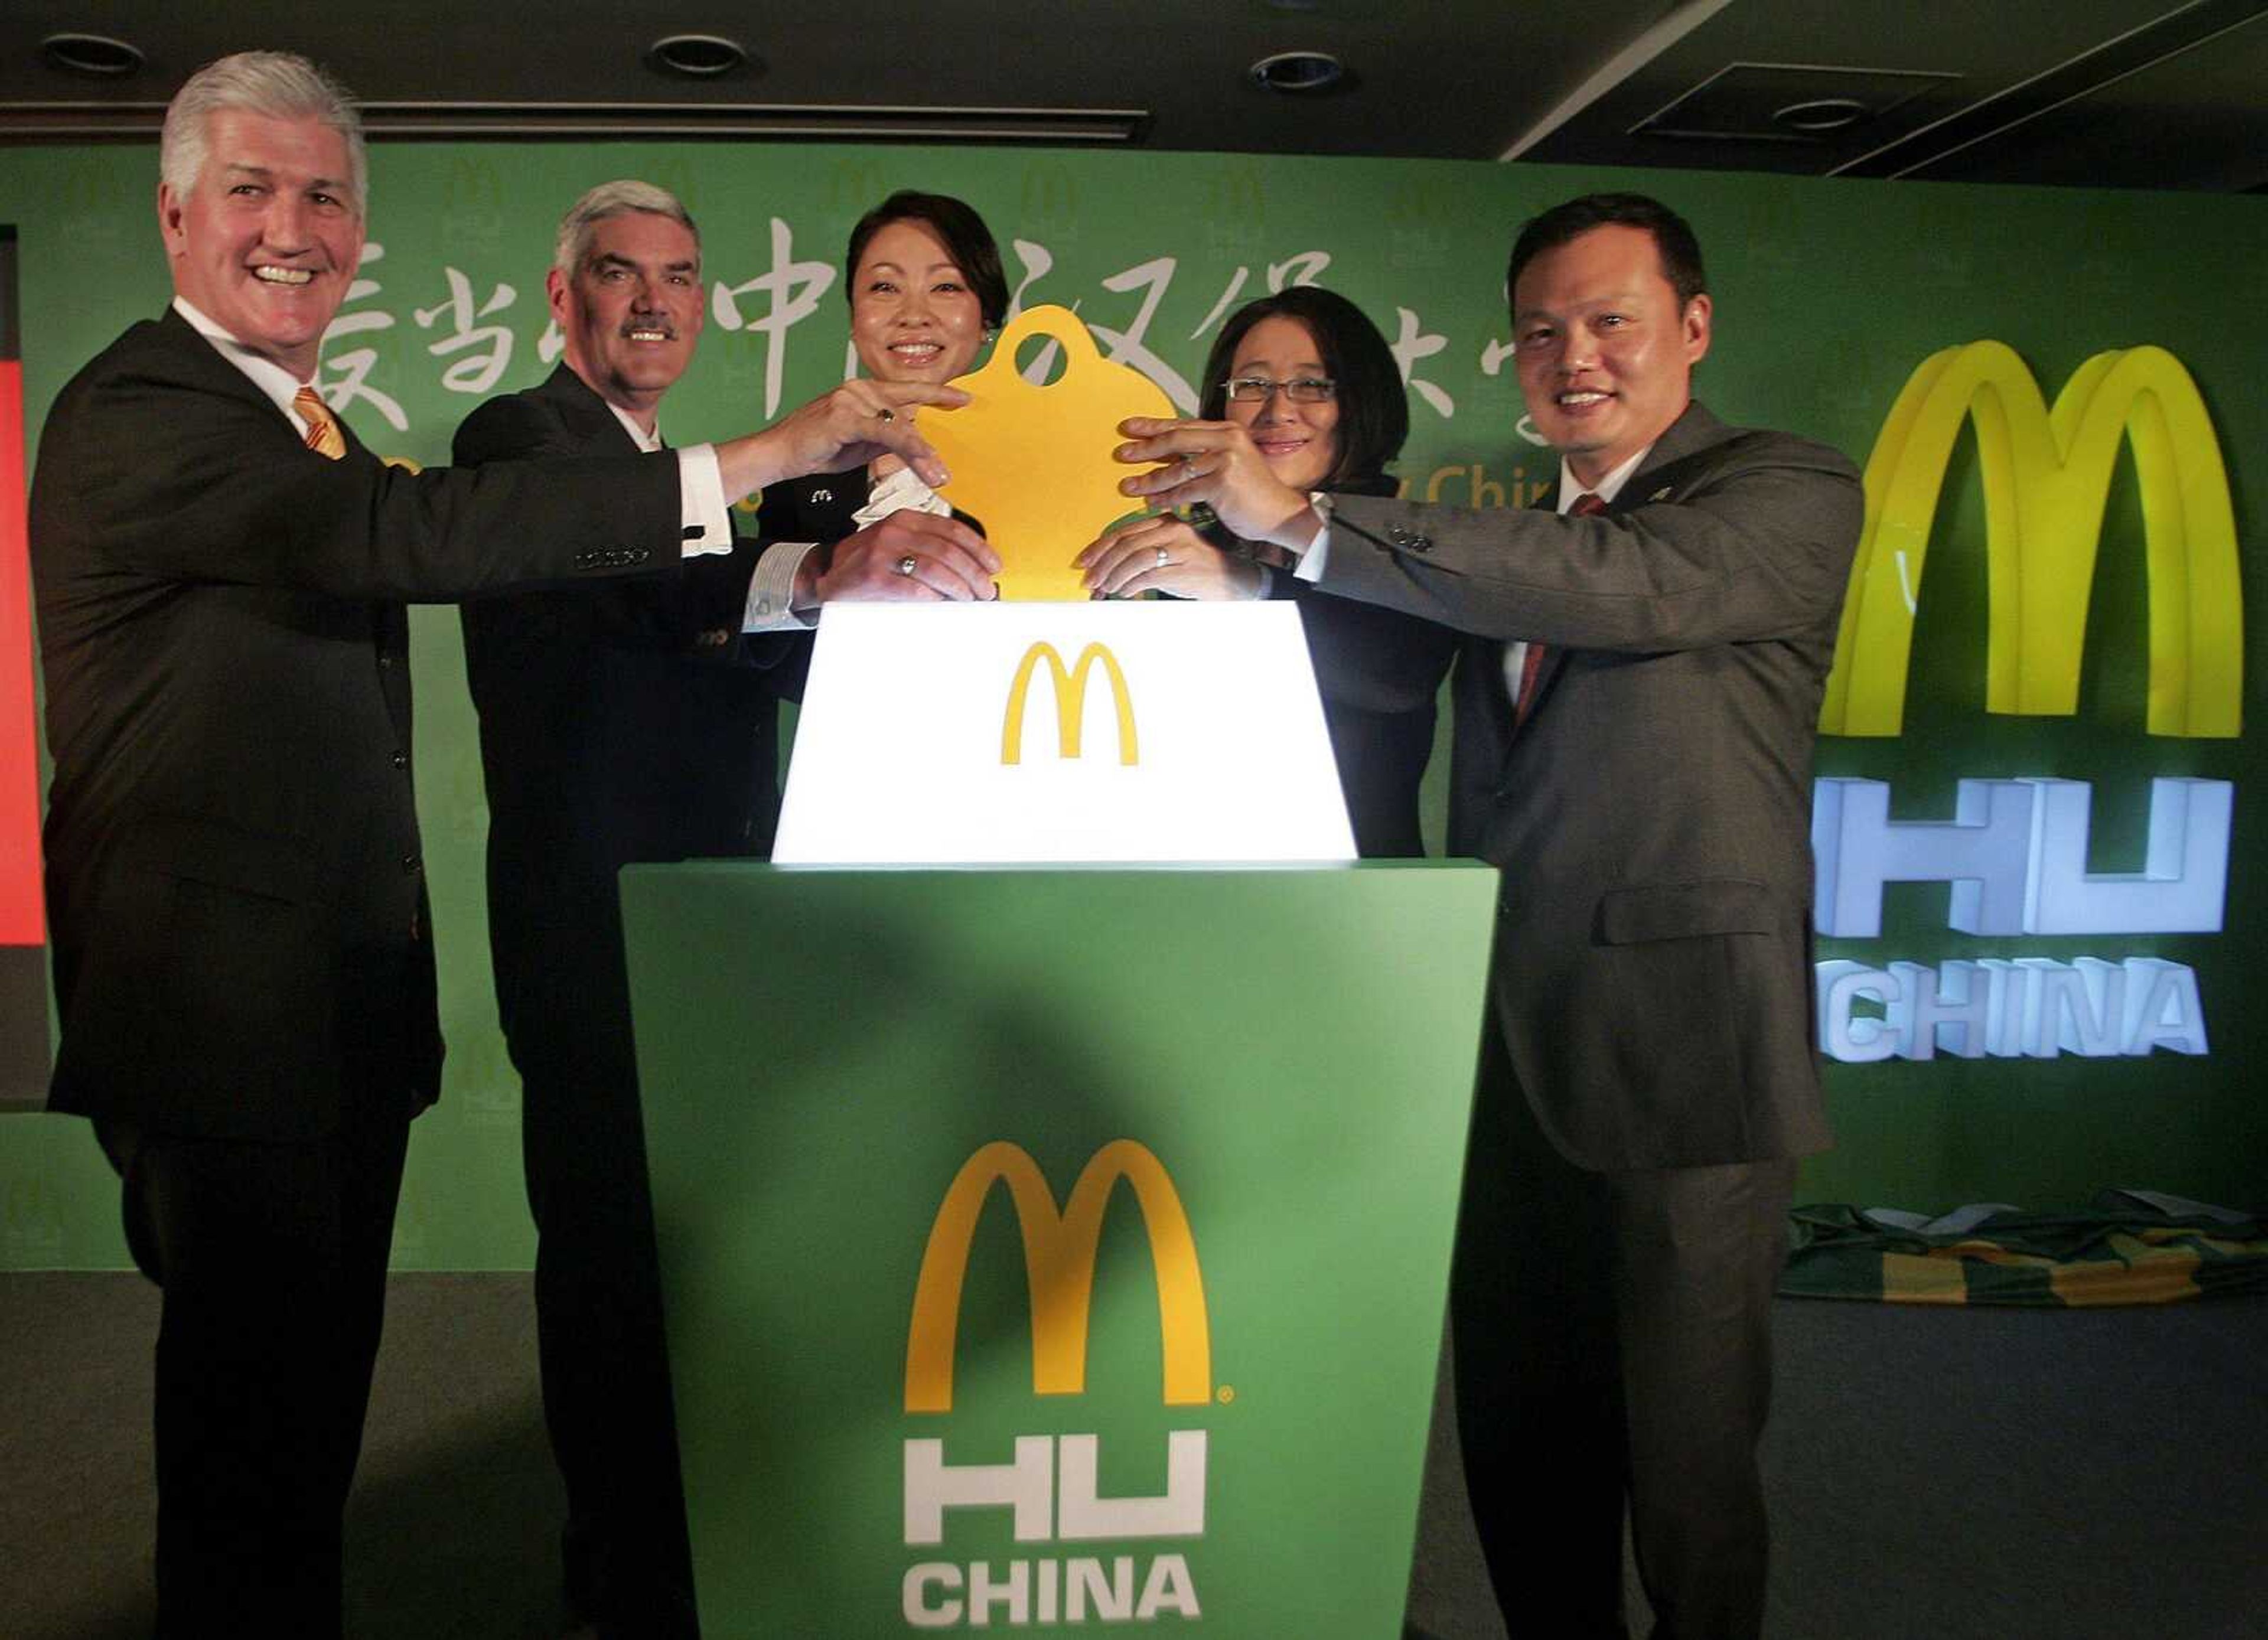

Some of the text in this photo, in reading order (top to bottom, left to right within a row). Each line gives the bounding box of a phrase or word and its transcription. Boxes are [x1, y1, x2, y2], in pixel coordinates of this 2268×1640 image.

[1812, 777, 2234, 938] HU
[1816, 956, 2209, 1063] CHINA
[904, 1429, 1207, 1544] HU
[902, 1553, 1201, 1628] CHINA
